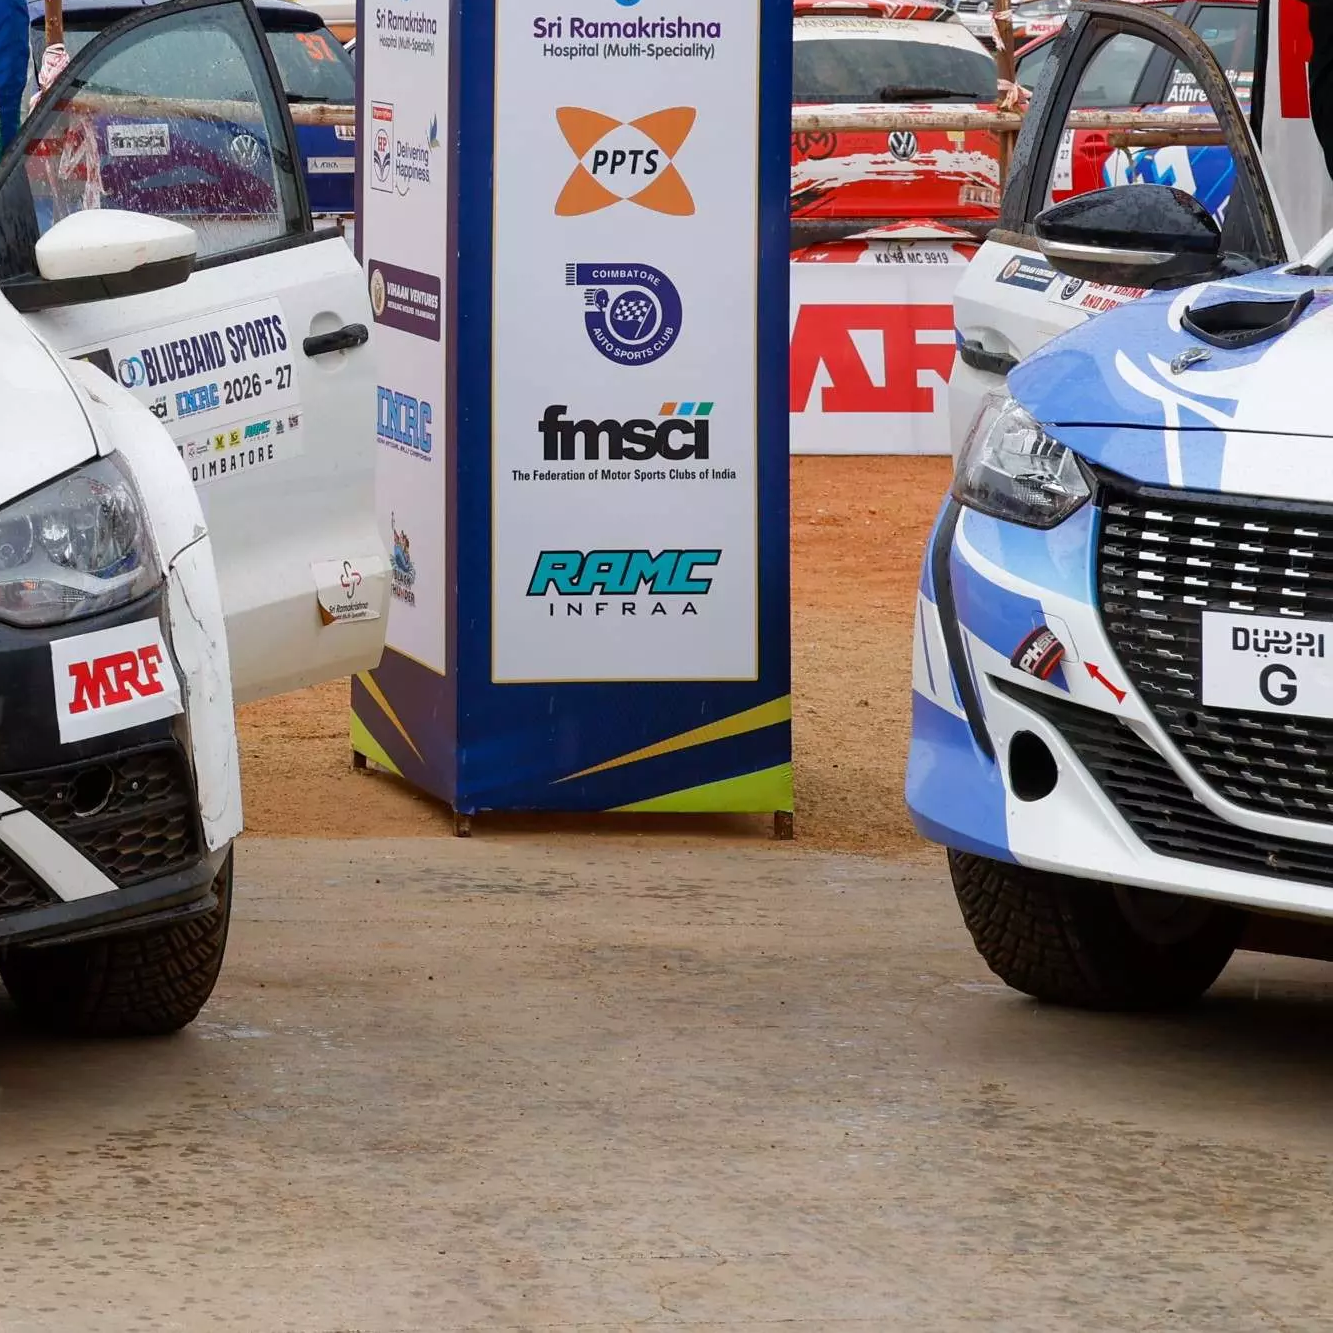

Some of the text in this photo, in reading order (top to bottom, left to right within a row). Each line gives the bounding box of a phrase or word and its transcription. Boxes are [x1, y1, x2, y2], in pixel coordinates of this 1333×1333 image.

[376, 8, 437, 34] Sri Ramakrishna
[533, 17, 721, 41] Sri Ramakrishna
[543, 43, 715, 61] Hospital (Multi-Speciality)
[377, 136, 387, 152] HP
[396, 140, 429, 167] Delivering
[591, 149, 660, 176] PPTS
[592, 269, 661, 287] COIMBATORE
[141, 315, 287, 387] BLUEBAND SPORTS
[593, 326, 675, 361] AUTO SPORTS CLUB
[224, 364, 291, 404] 2026 27
[376, 385, 432, 454] INRC
[538, 404, 710, 461] fmsci
[192, 444, 274, 481] OIMBATORE
[512, 468, 737, 483] The Federation of Motor Sports Clubs India
[526, 550, 722, 597] RAMC
[549, 602, 698, 616] INFRAA
[1233, 626, 1325, 658] DUBAI
[68, 645, 163, 714] MRF
[1259, 664, 1298, 706] G
